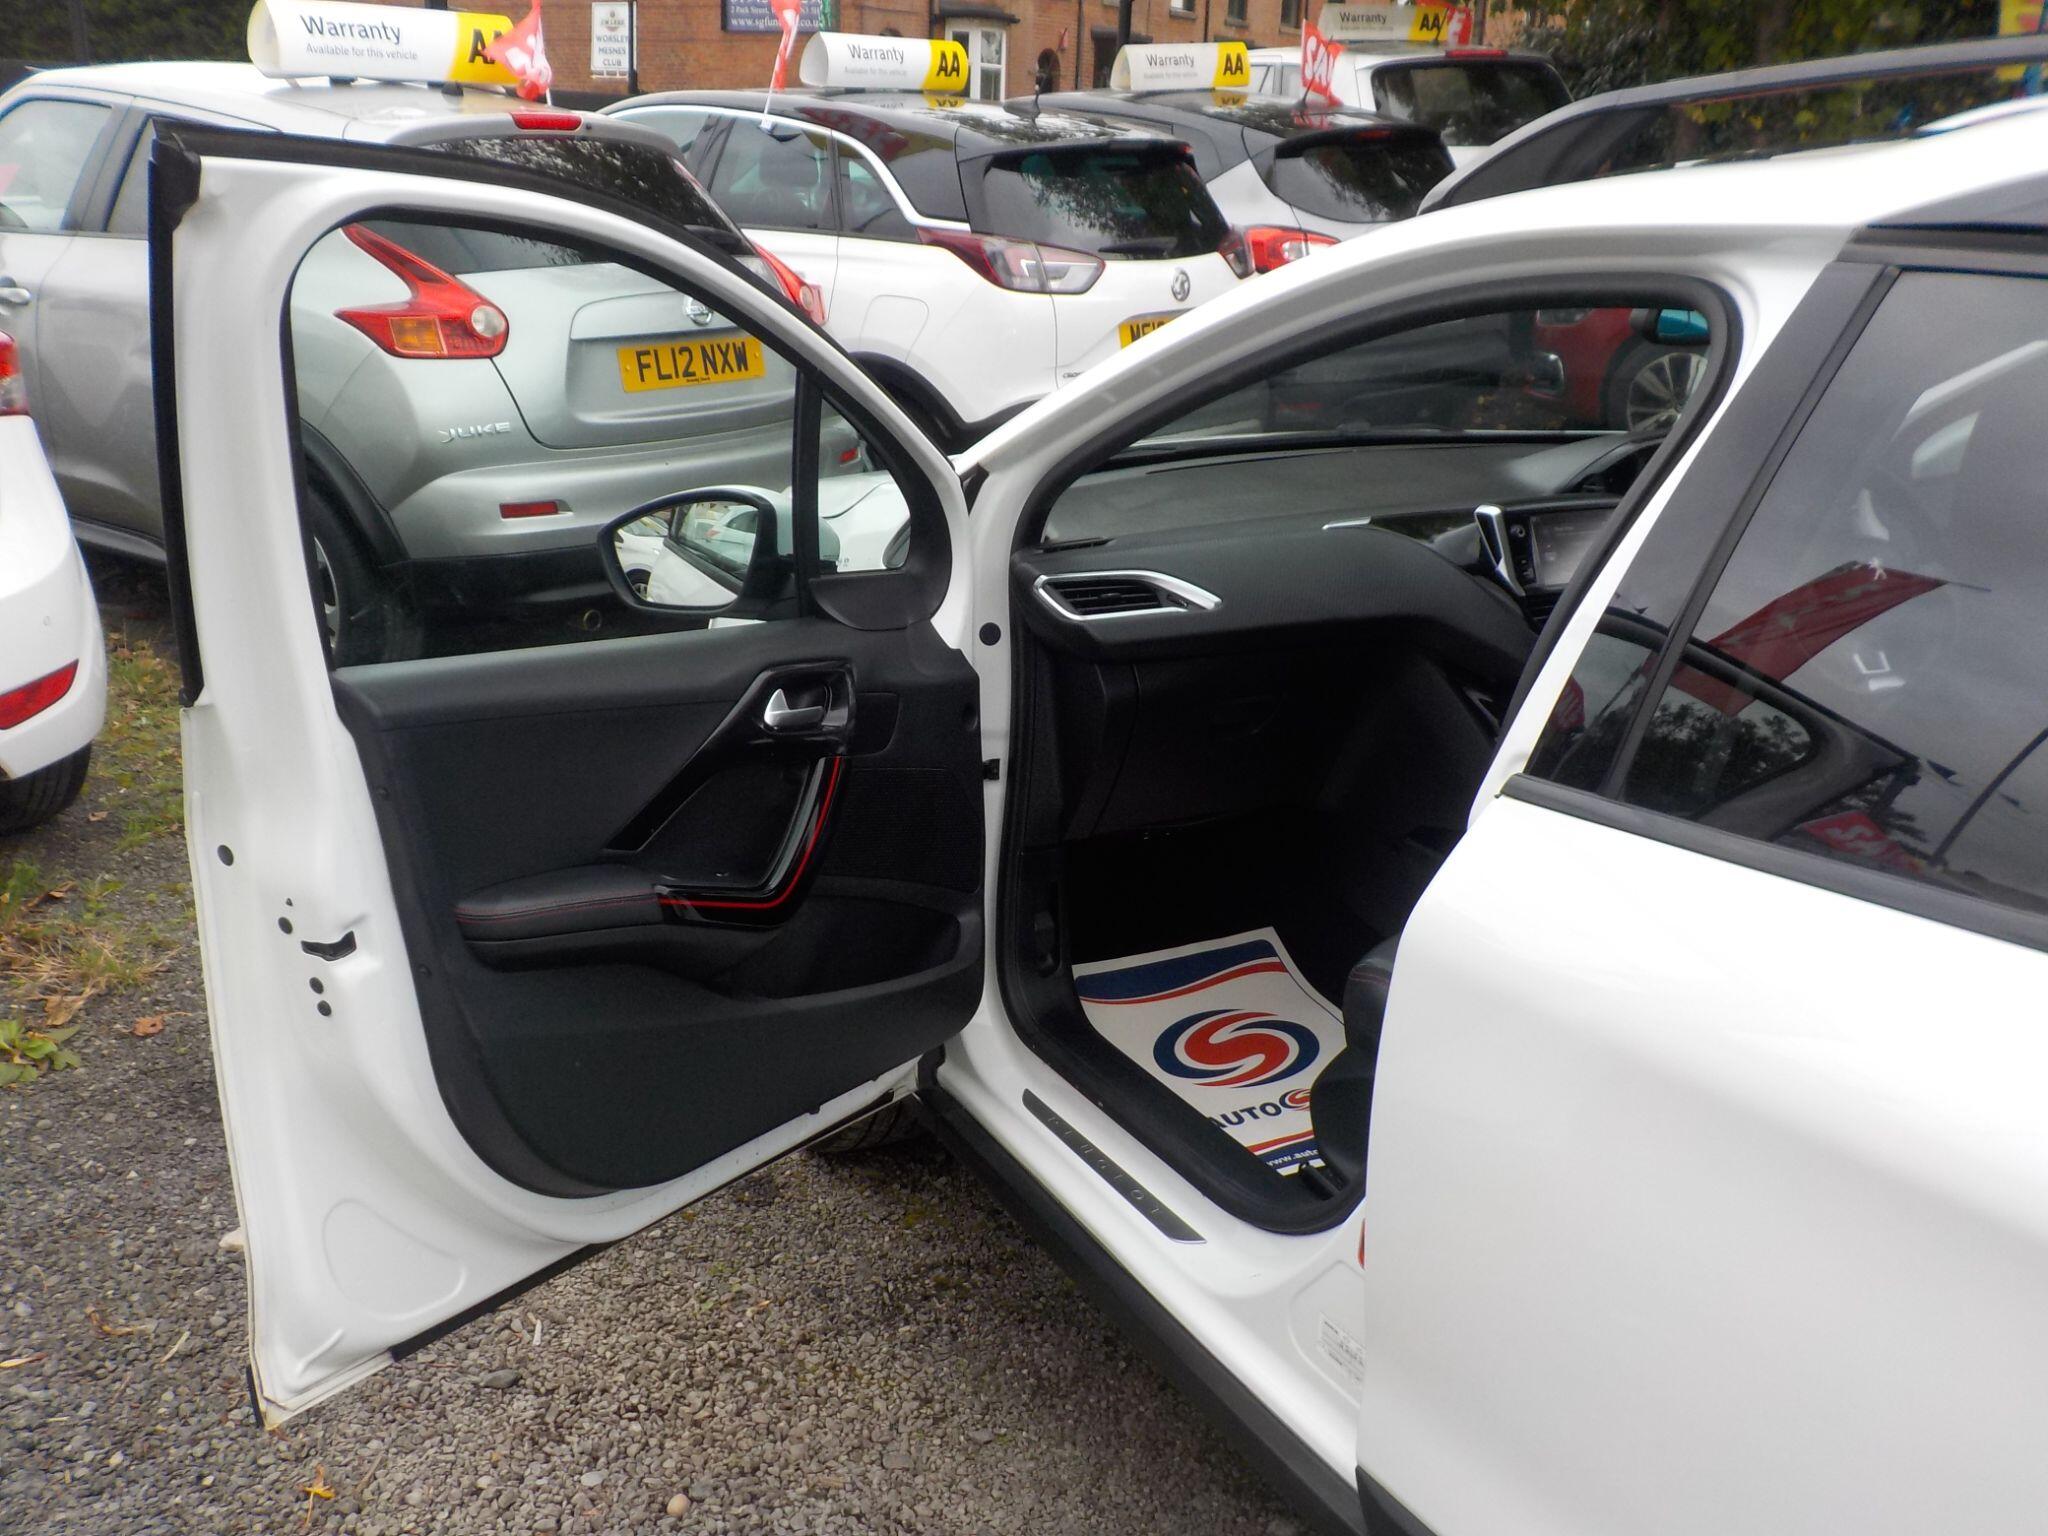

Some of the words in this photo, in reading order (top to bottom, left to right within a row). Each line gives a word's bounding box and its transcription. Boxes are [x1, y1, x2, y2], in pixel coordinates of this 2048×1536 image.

[1339, 11, 1387, 24] Warranty
[1419, 13, 1441, 32] AA
[300, 15, 401, 45] Warranty
[305, 42, 349, 56] Available
[352, 45, 364, 57] for
[366, 46, 384, 58] this
[386, 48, 418, 61] vehicle
[847, 43, 904, 65] Warranty
[1145, 53, 1195, 68] Warranty
[602, 59, 622, 67] CLUB
[936, 50, 960, 77] AA
[1222, 53, 1244, 76] AA
[635, 346, 697, 382] FL12
[700, 341, 749, 376] NXW
[438, 421, 511, 443] JUKE
